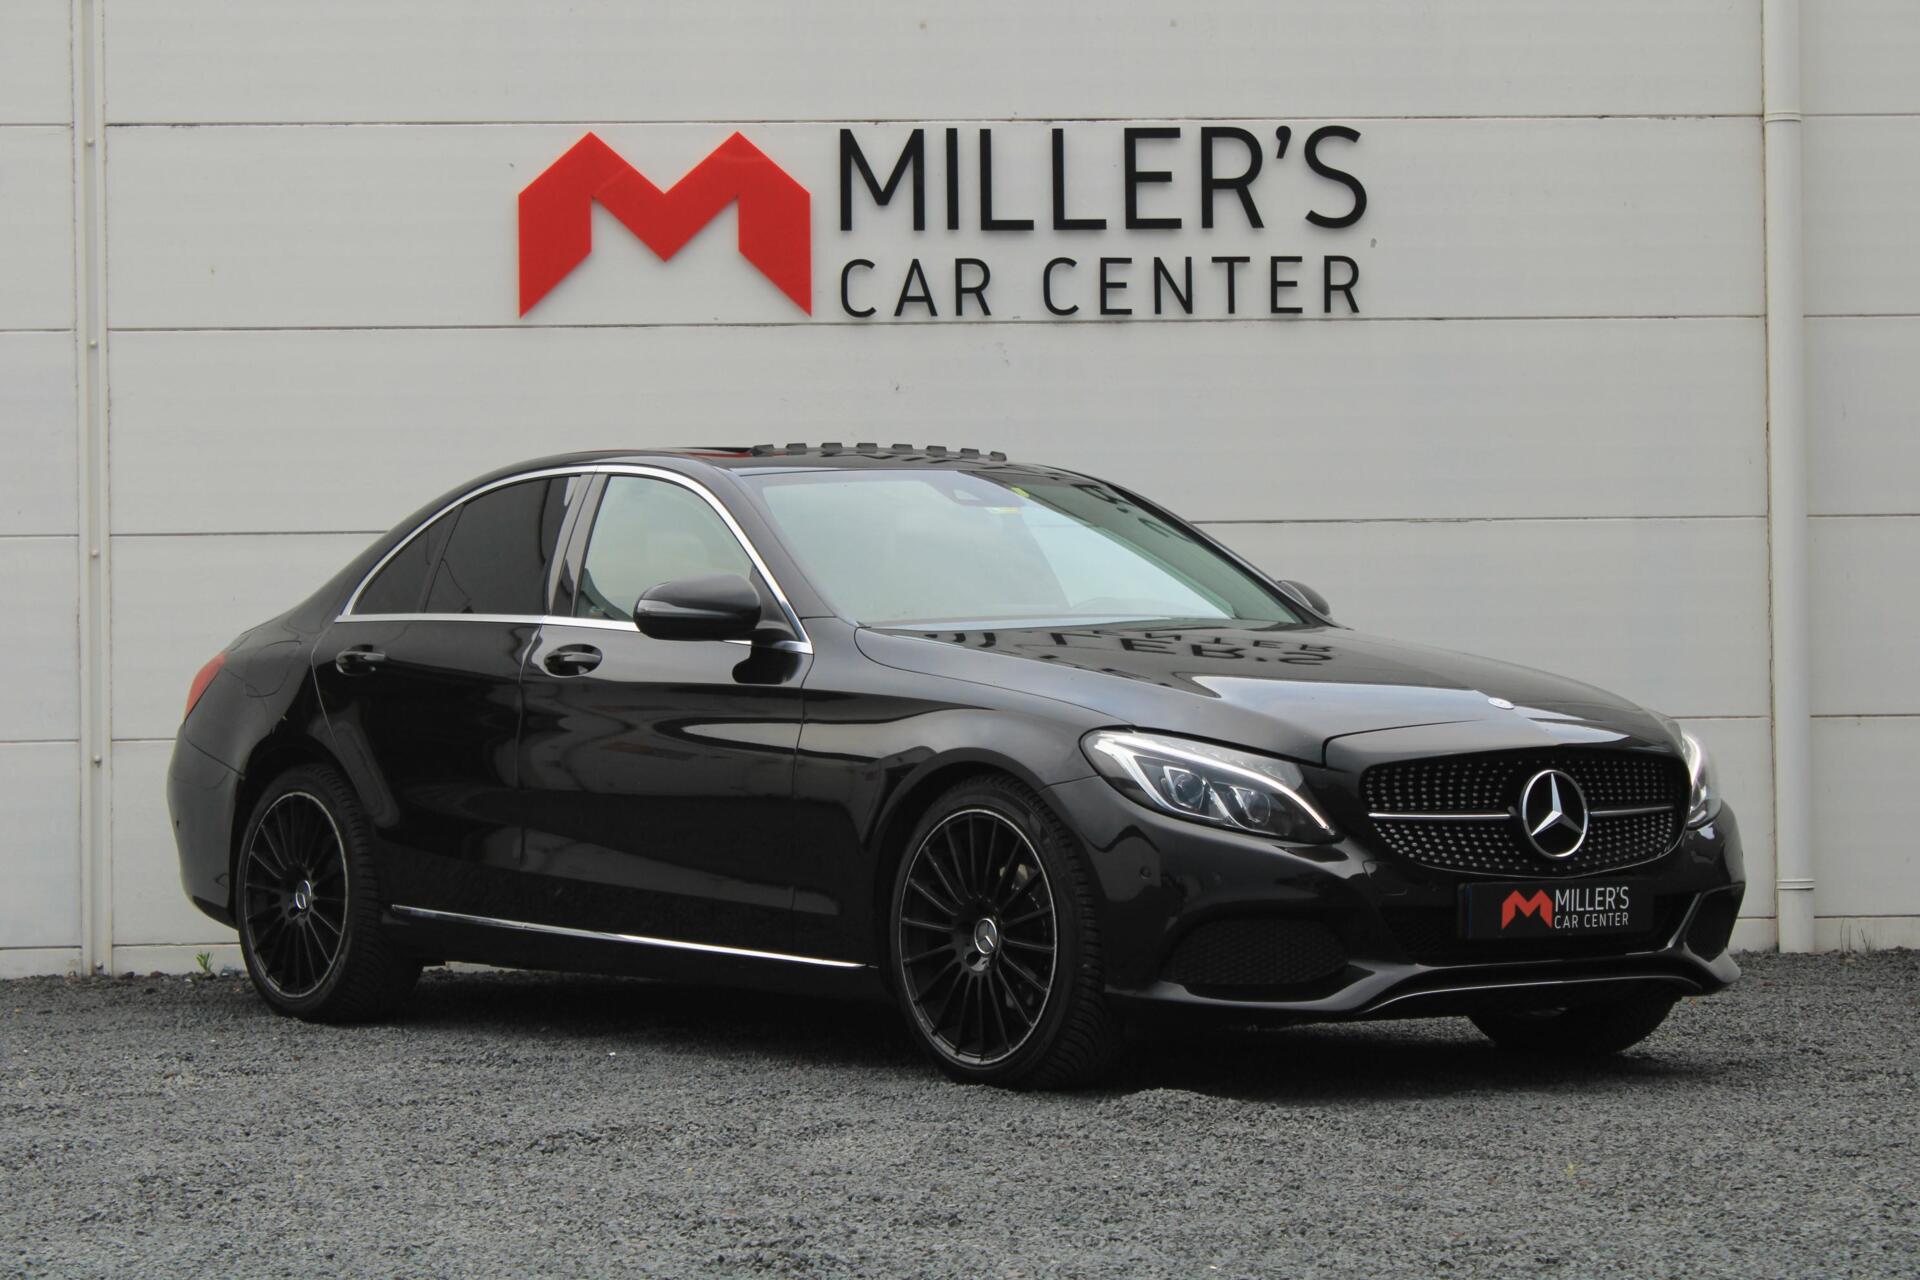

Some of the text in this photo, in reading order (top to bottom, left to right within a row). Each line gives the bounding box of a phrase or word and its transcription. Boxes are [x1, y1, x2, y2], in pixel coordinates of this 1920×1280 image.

[840, 125, 1368, 231] MILLER'S
[840, 255, 1360, 319] CAR CENTER
[1554, 911, 1629, 929] CAR CENTER
[1555, 886, 1630, 913] MILLER'S
